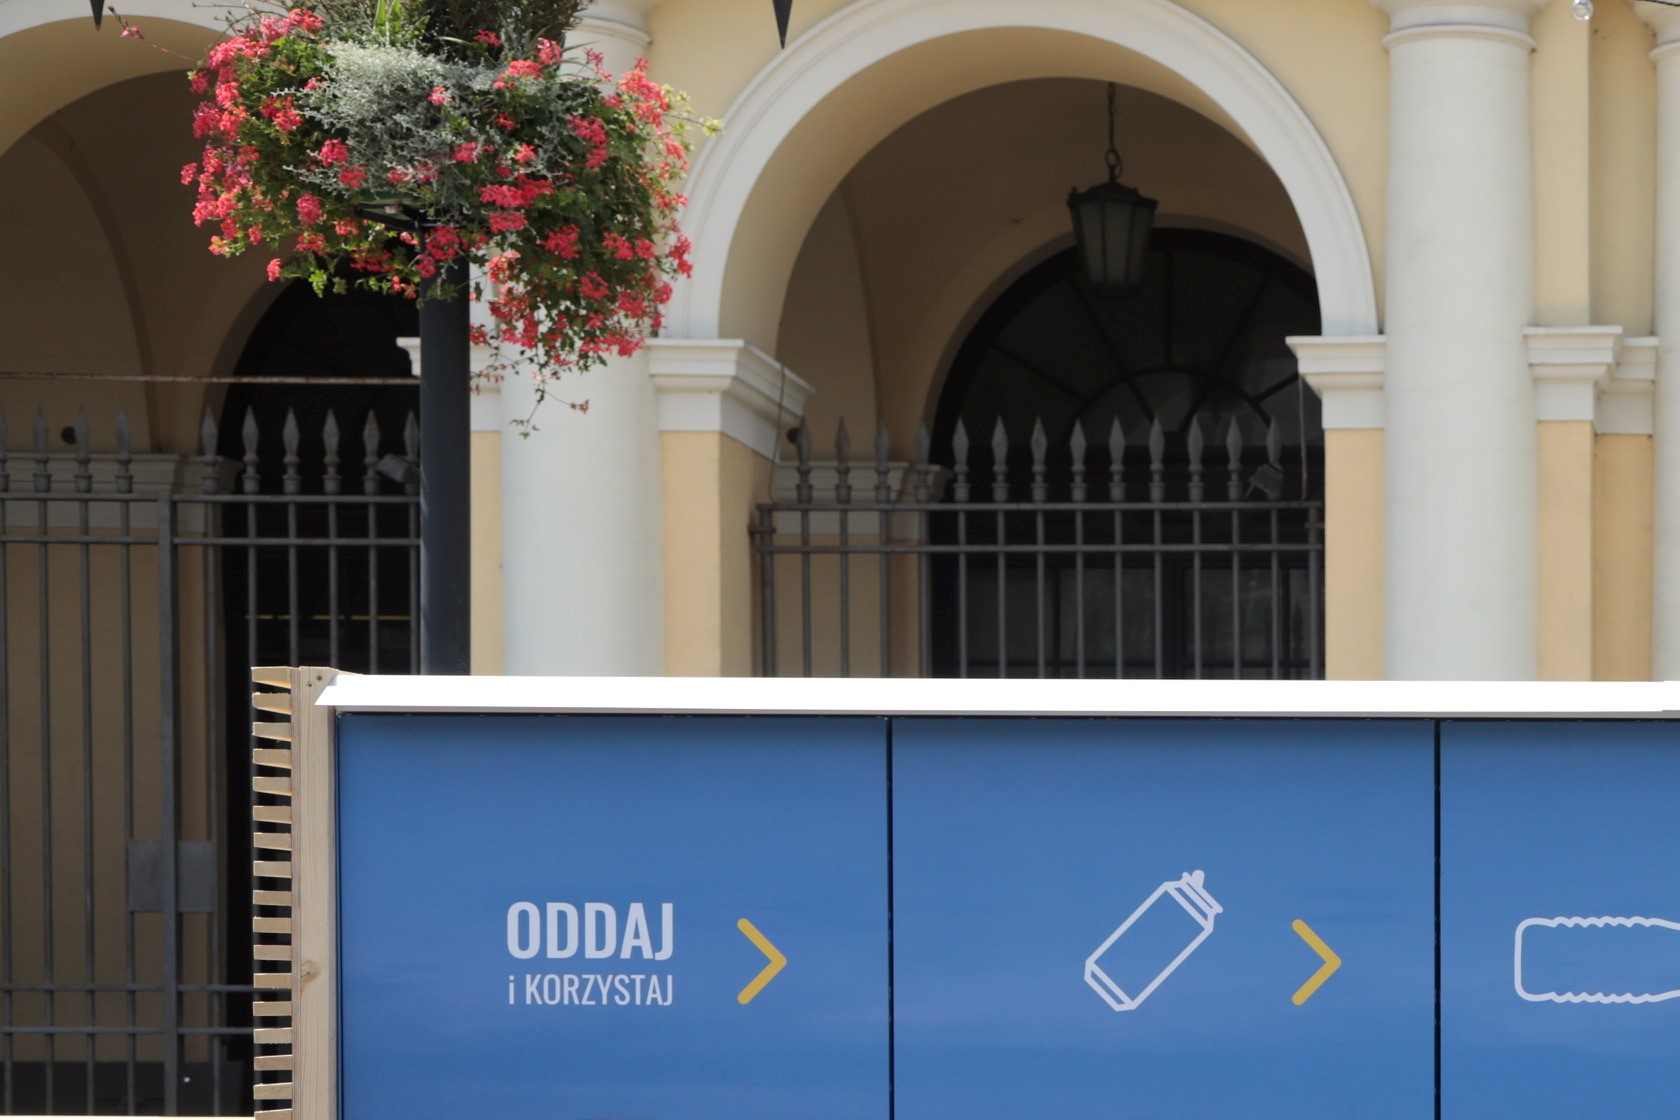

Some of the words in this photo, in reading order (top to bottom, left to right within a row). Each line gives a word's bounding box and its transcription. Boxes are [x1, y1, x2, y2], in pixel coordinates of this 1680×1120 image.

[507, 901, 674, 961] ODDAJ
[508, 975, 515, 1005] i
[525, 974, 673, 1006] KORZYSTAJ
